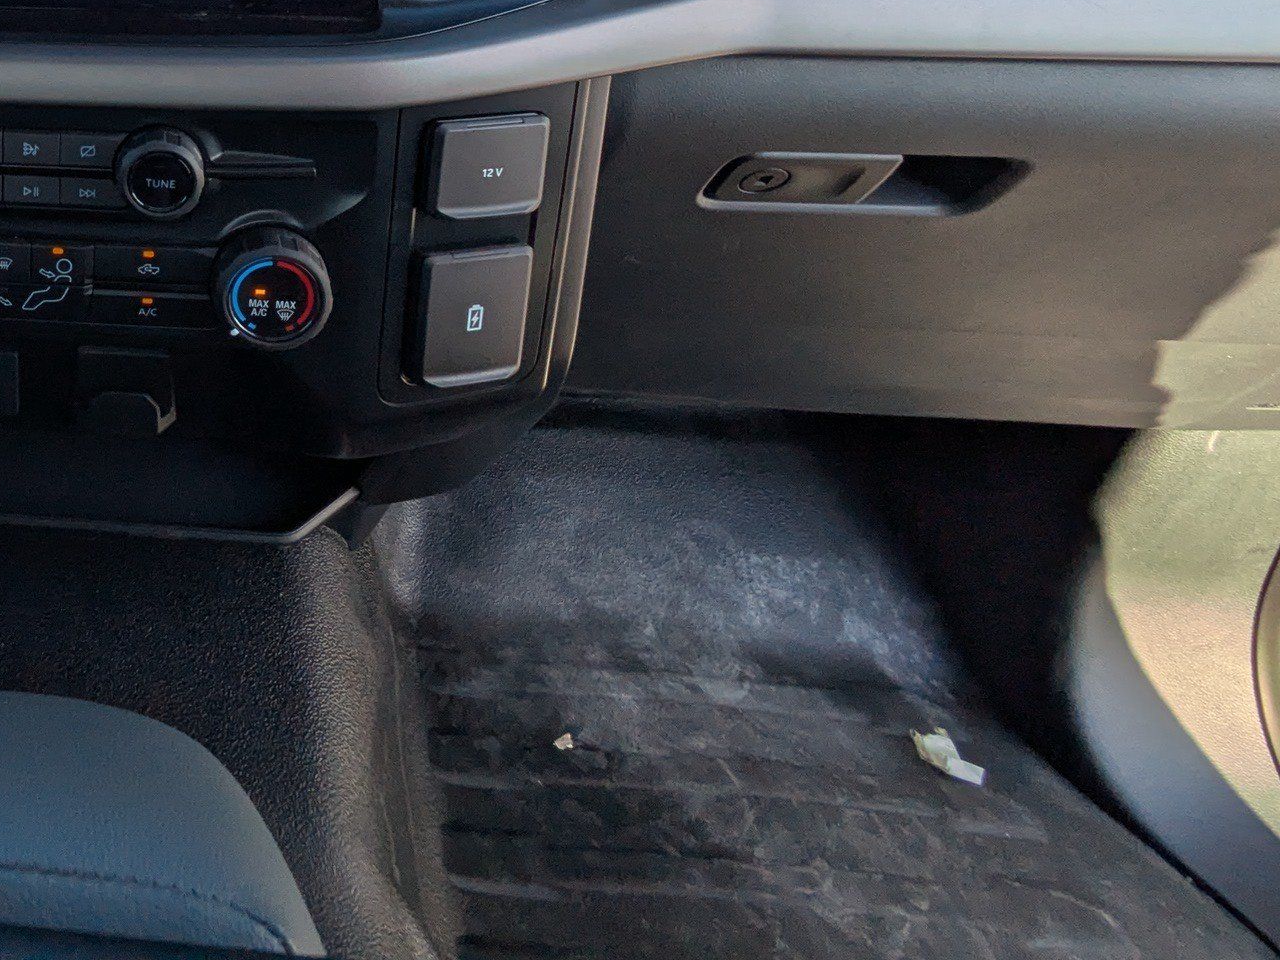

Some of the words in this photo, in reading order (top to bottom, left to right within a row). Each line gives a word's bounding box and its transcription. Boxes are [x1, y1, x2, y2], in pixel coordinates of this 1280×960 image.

[482, 168, 493, 178] 12
[145, 178, 176, 189] TUNE
[248, 298, 270, 309] MAX
[275, 300, 297, 310] MAX
[138, 307, 158, 317] A/C
[250, 307, 268, 317] A/C
